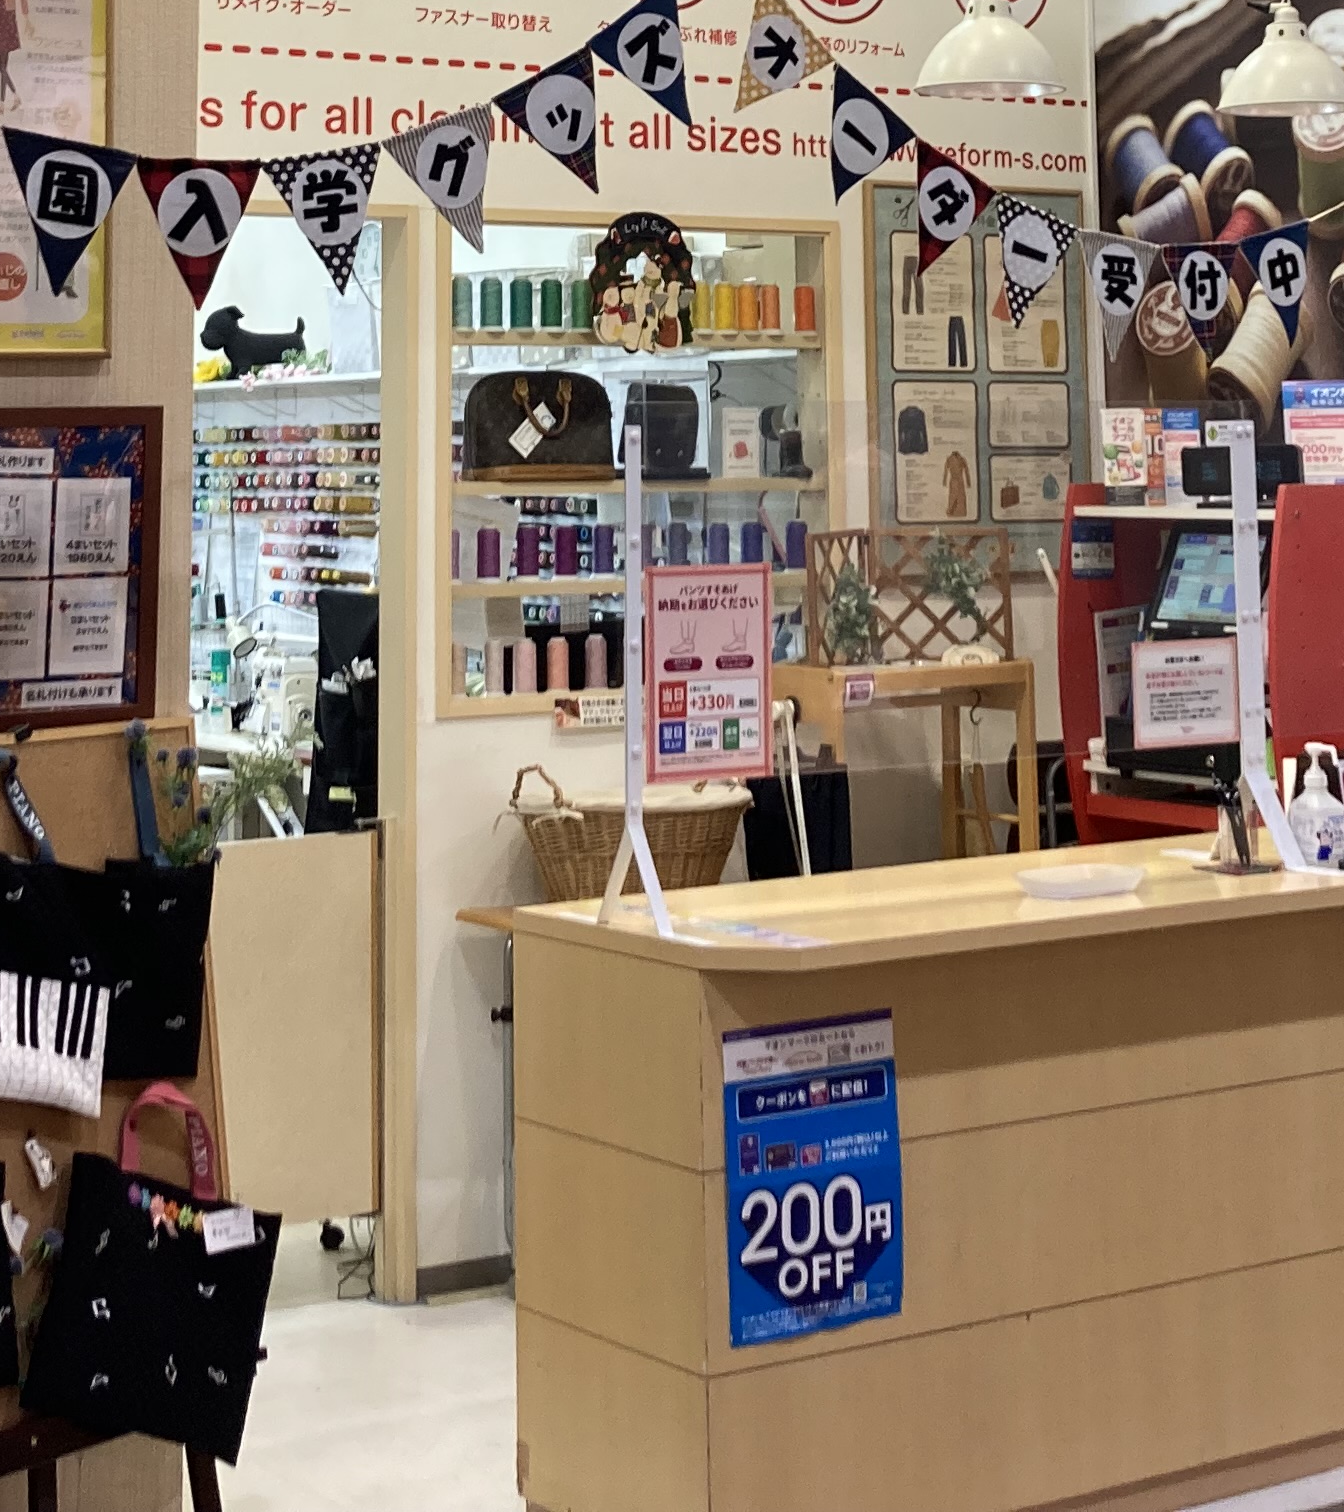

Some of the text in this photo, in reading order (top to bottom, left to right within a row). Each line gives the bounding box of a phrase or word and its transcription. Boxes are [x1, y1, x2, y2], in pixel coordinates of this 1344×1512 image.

[415, 7, 553, 34] ファスナー取り替え
[241, 90, 308, 132] for
[324, 95, 373, 135] all
[629, 112, 671, 150] all
[687, 117, 782, 155] sizes
[740, 1174, 893, 1268] 200円
[777, 1247, 856, 1299] OFF
